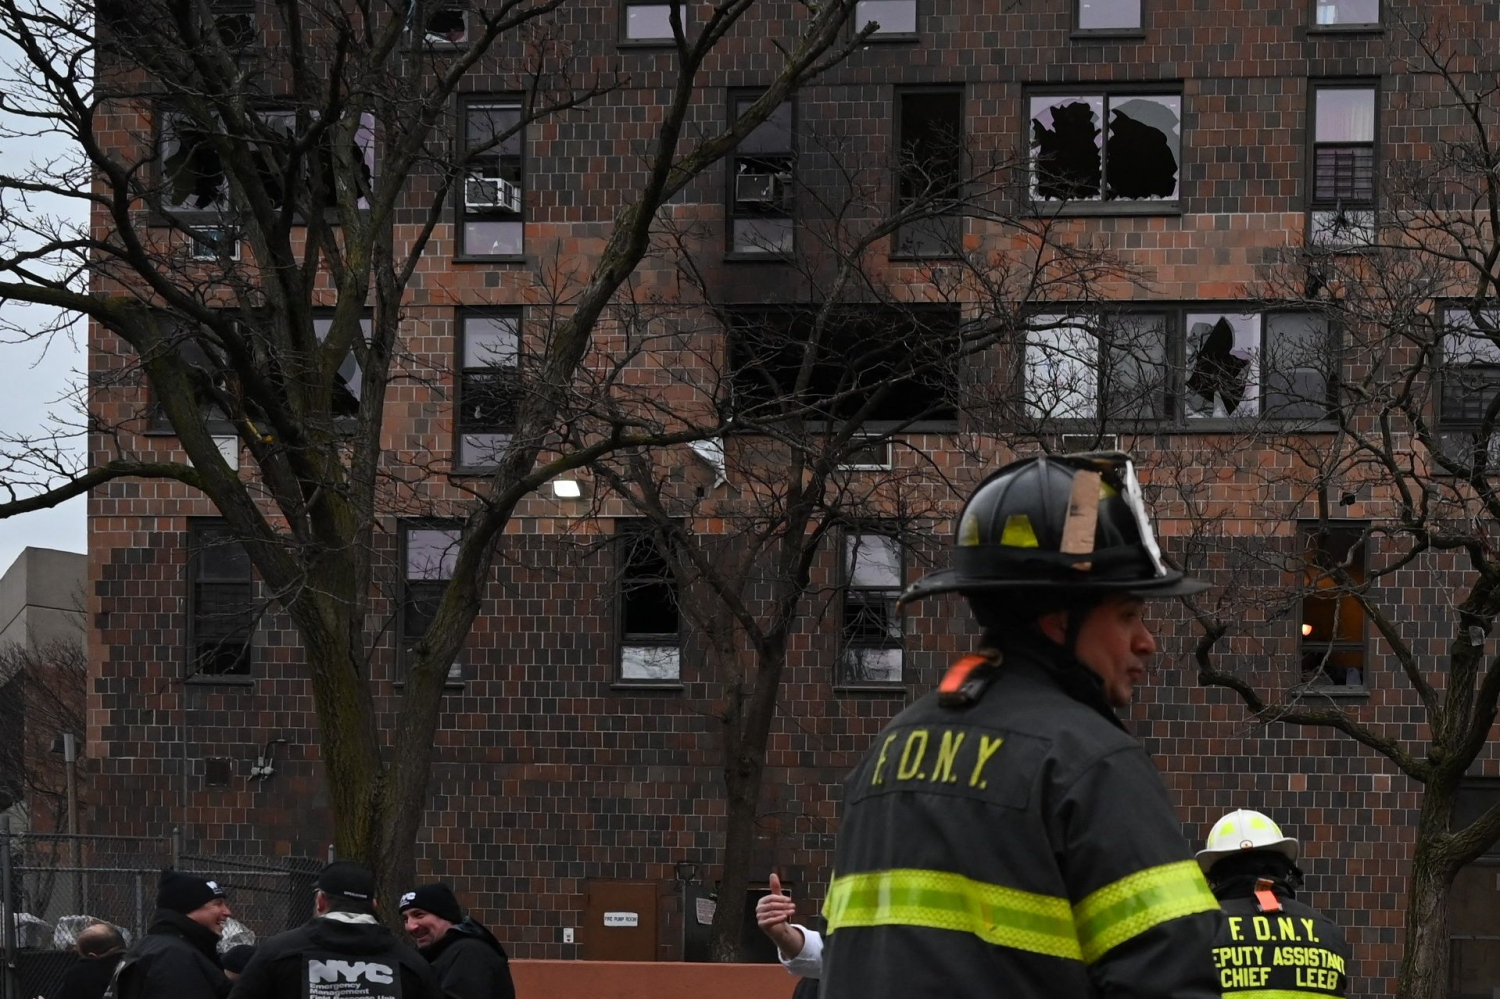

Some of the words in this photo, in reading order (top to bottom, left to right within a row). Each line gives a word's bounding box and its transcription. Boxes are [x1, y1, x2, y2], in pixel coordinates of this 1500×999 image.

[308, 959, 394, 985] NYC
[1211, 946, 1263, 968] EPUTY
[1273, 946, 1346, 976] ASSISTANT
[309, 982, 361, 990] Emergency
[1220, 967, 1272, 988] CHIEF
[1296, 967, 1339, 990] LEEB
[309, 988, 370, 997] Management
